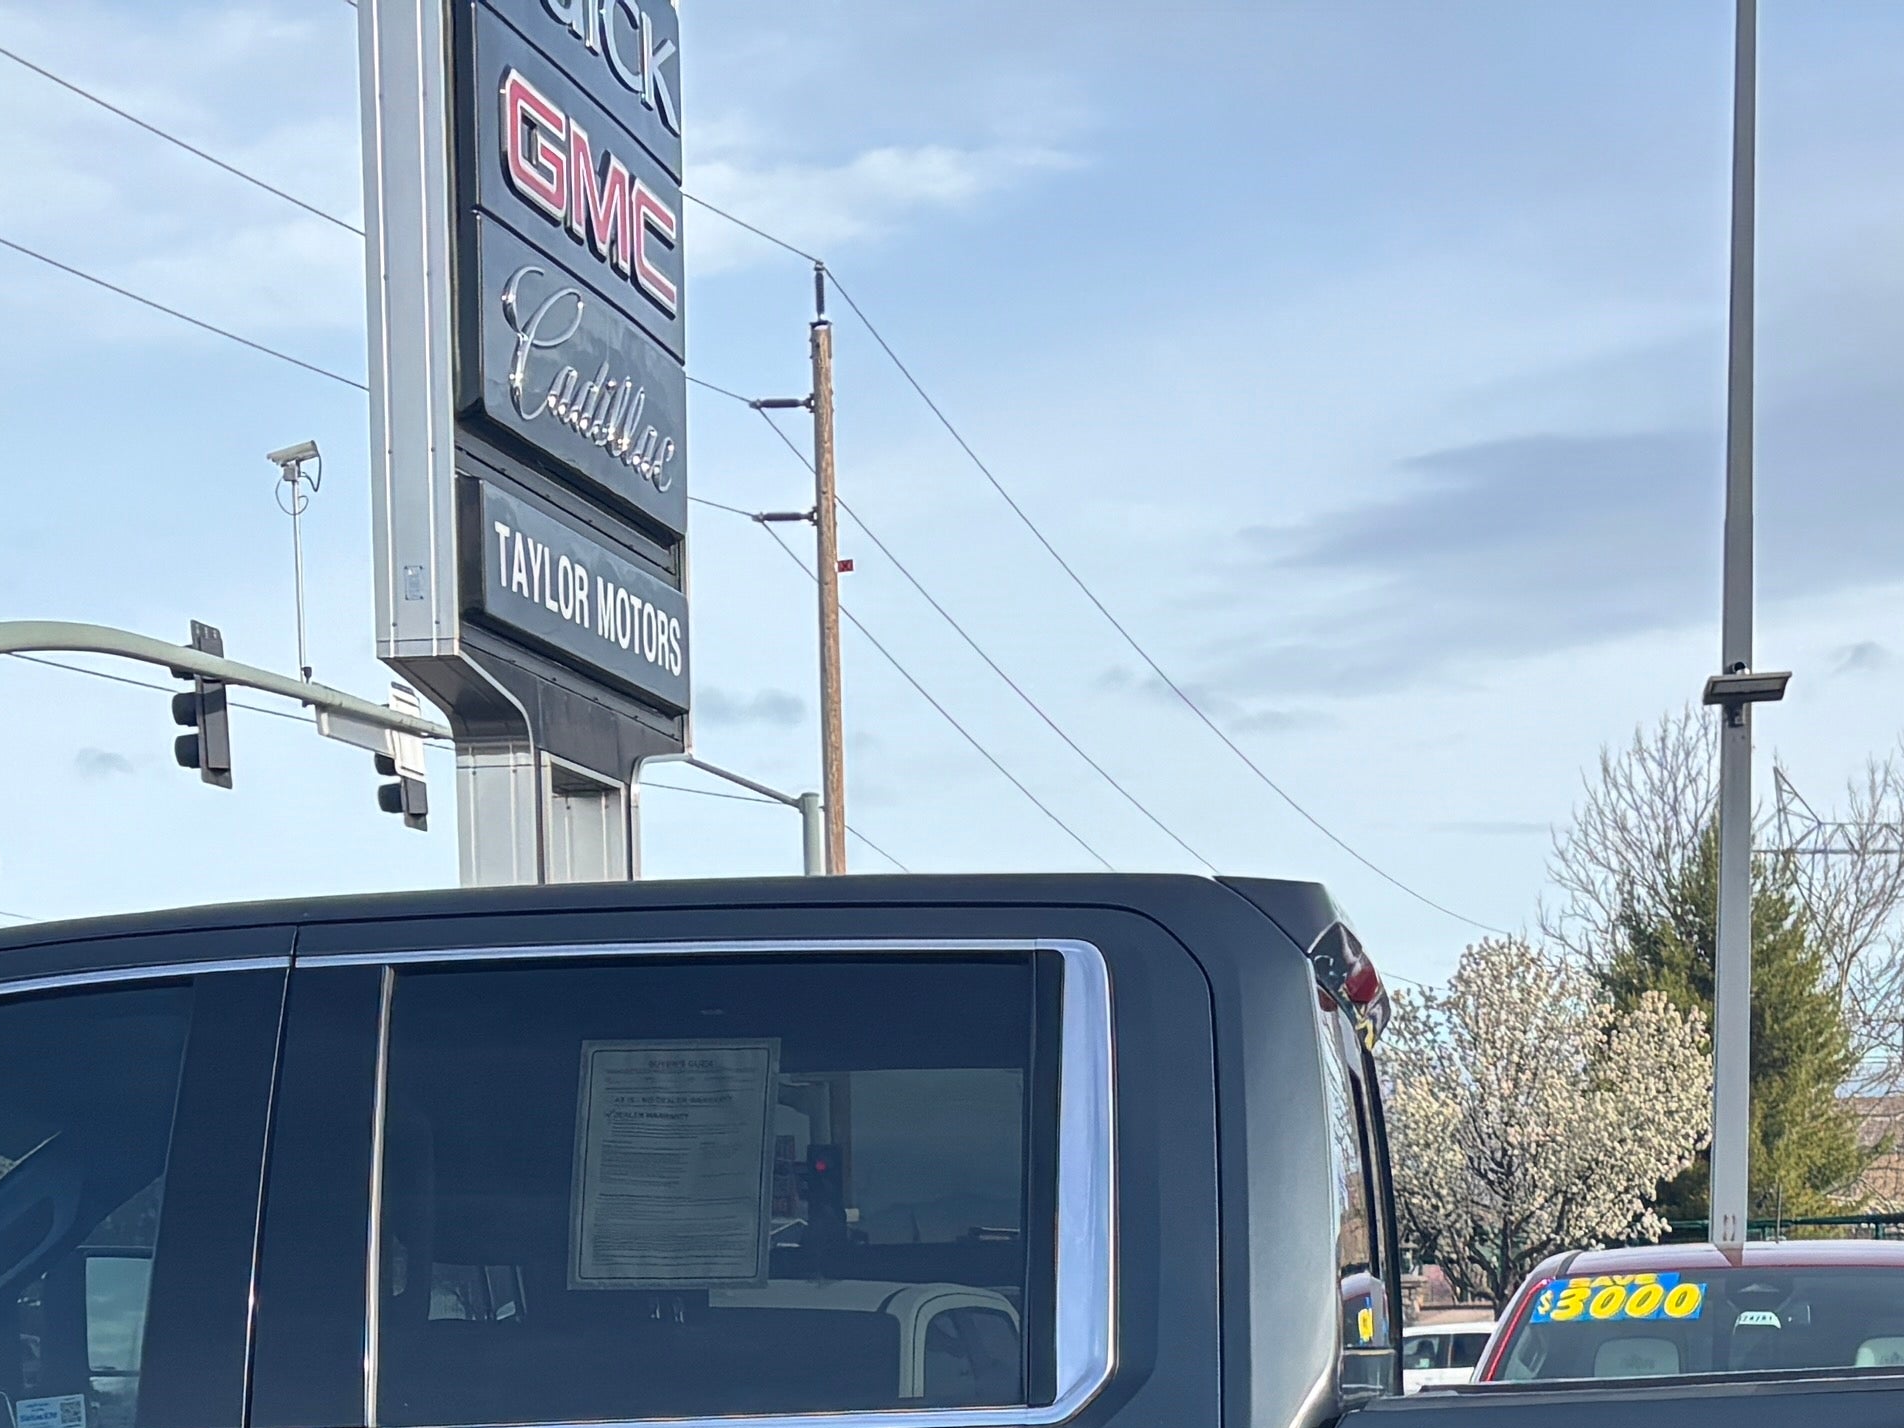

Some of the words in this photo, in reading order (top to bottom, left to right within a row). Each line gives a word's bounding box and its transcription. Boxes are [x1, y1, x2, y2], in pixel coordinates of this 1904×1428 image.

[501, 67, 677, 319] GMC
[502, 266, 675, 494] Cadillac
[494, 520, 590, 630] TAYLOR
[597, 575, 682, 678] MOTORS
[1537, 1283, 1702, 1321] $3000
